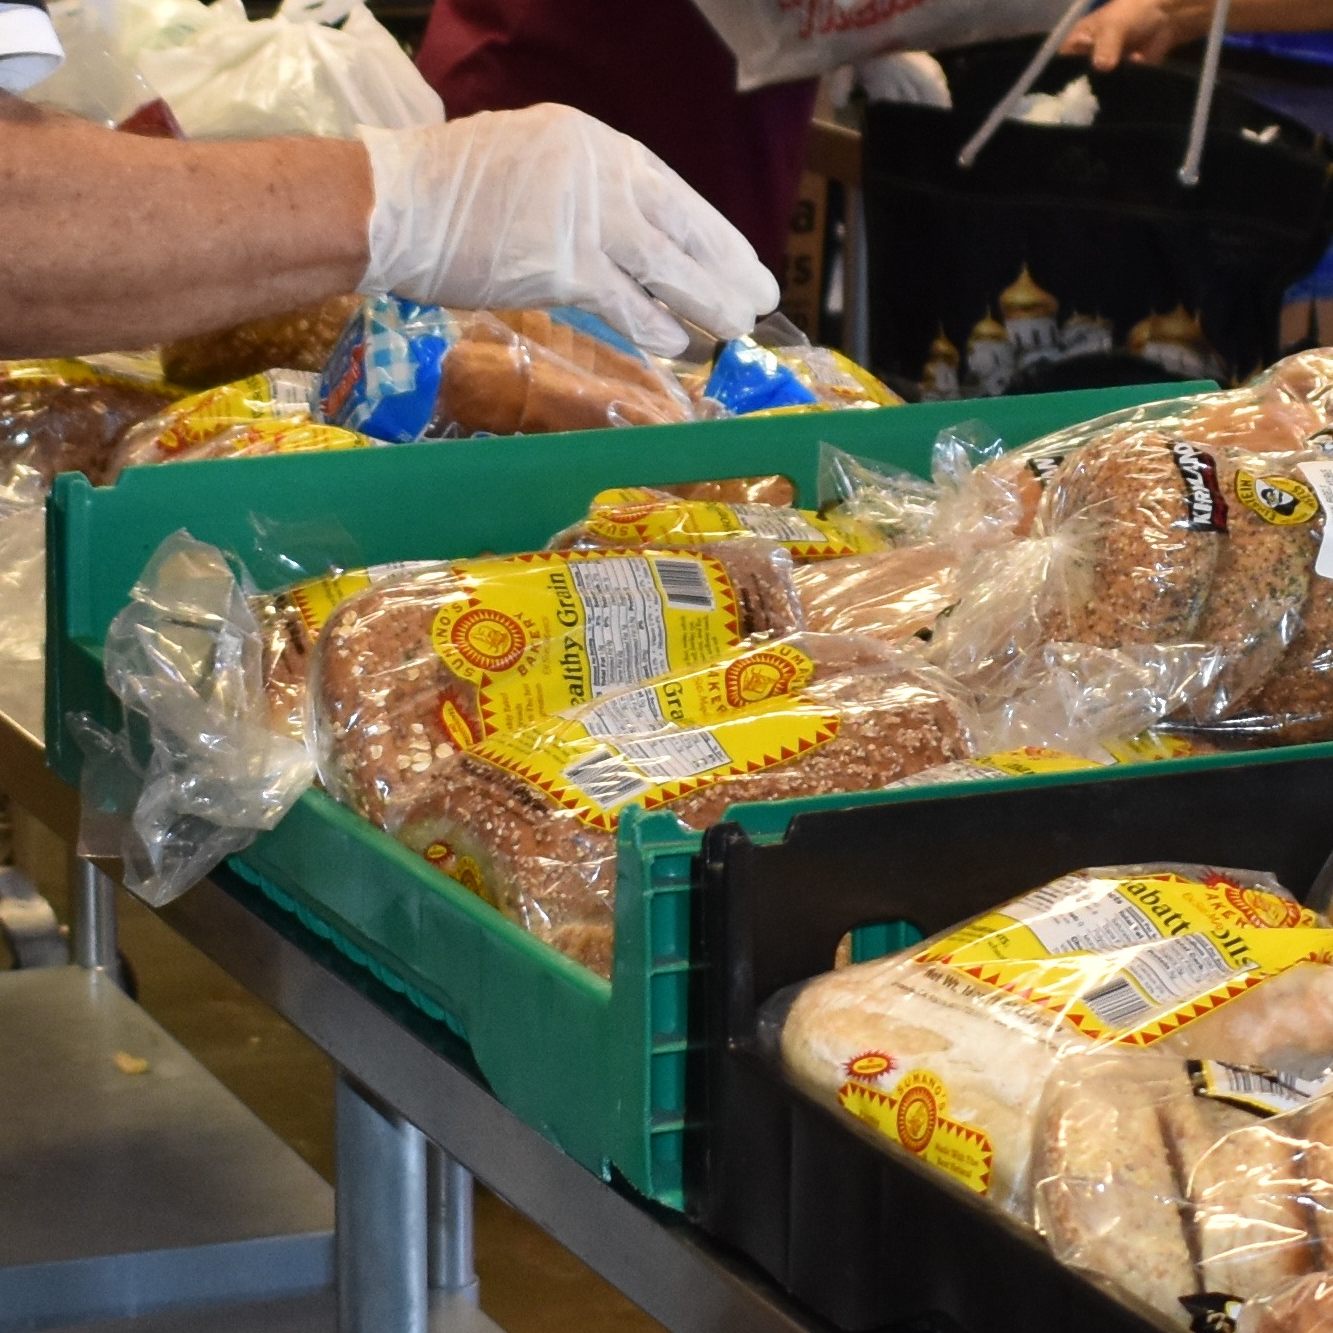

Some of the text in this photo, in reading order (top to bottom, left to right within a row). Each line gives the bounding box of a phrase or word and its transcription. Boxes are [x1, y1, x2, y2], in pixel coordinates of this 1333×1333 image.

[547, 571, 579, 628] Grain
[512, 611, 541, 677] BAKERY
[563, 634, 585, 706] ealthy
[662, 681, 685, 721] Gra
[1122, 879, 1252, 967] abatt olls
